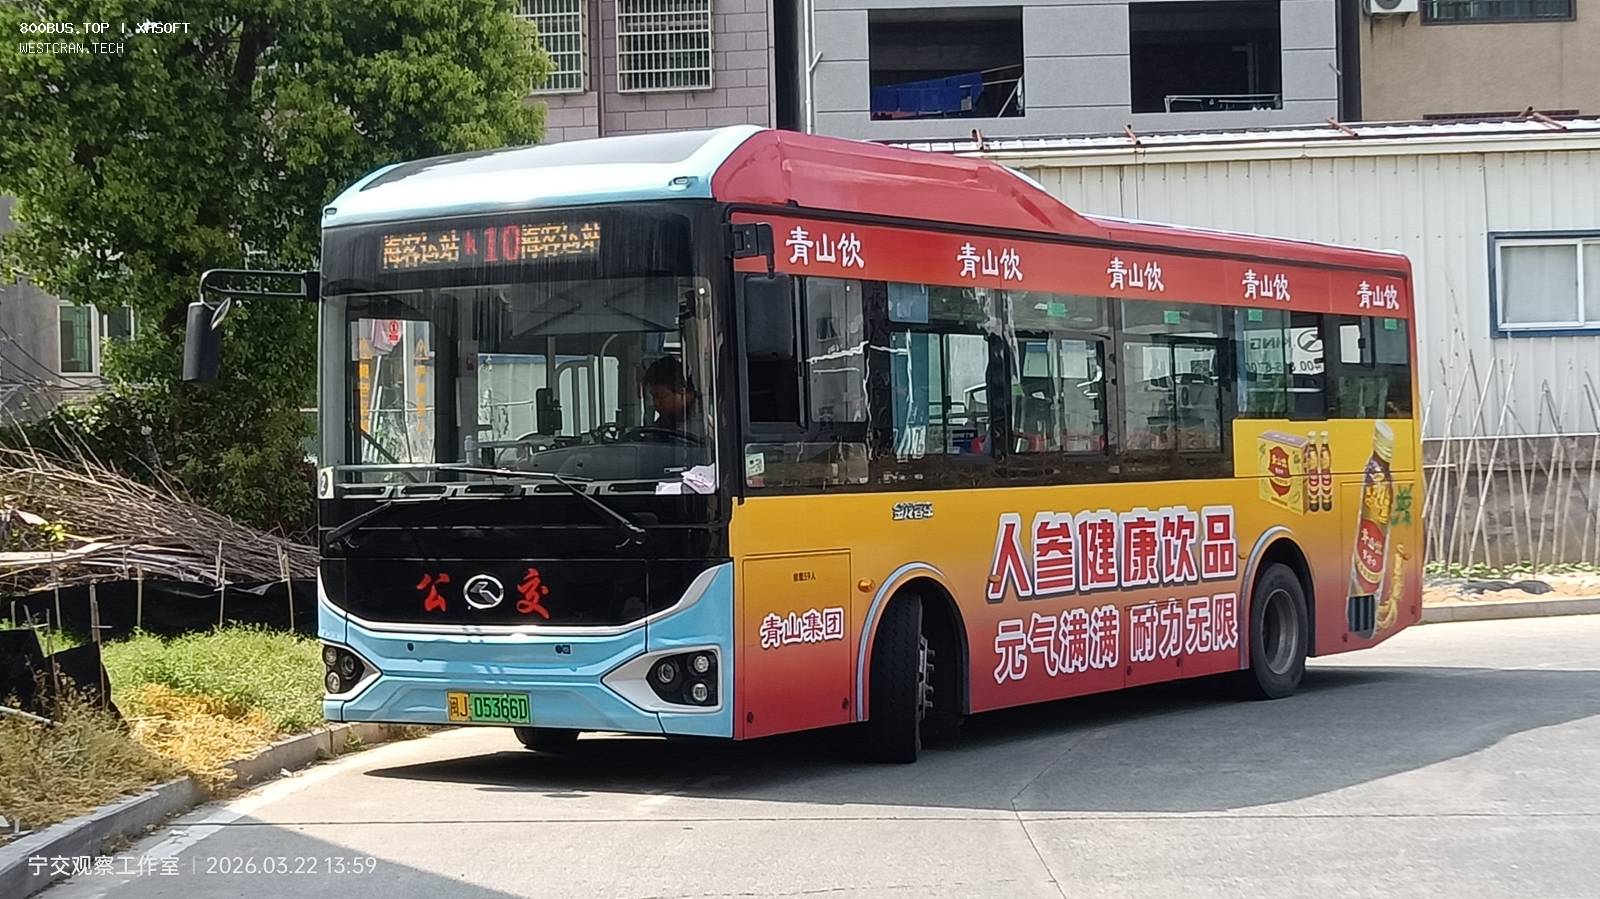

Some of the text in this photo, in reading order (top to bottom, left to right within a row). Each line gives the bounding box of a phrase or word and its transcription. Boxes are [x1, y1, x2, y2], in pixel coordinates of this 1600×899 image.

[785, 225, 865, 269] 青山饮
[956, 241, 1024, 282] 青山饮
[1106, 256, 1165, 292] 青山饮
[1241, 268, 1291, 302] 青山饮
[1356, 280, 1400, 310] 青山饮
[986, 505, 1239, 604] 人参健康饮品
[760, 606, 845, 650] 青山集团
[993, 592, 1239, 685] 元气满满 耐力无限
